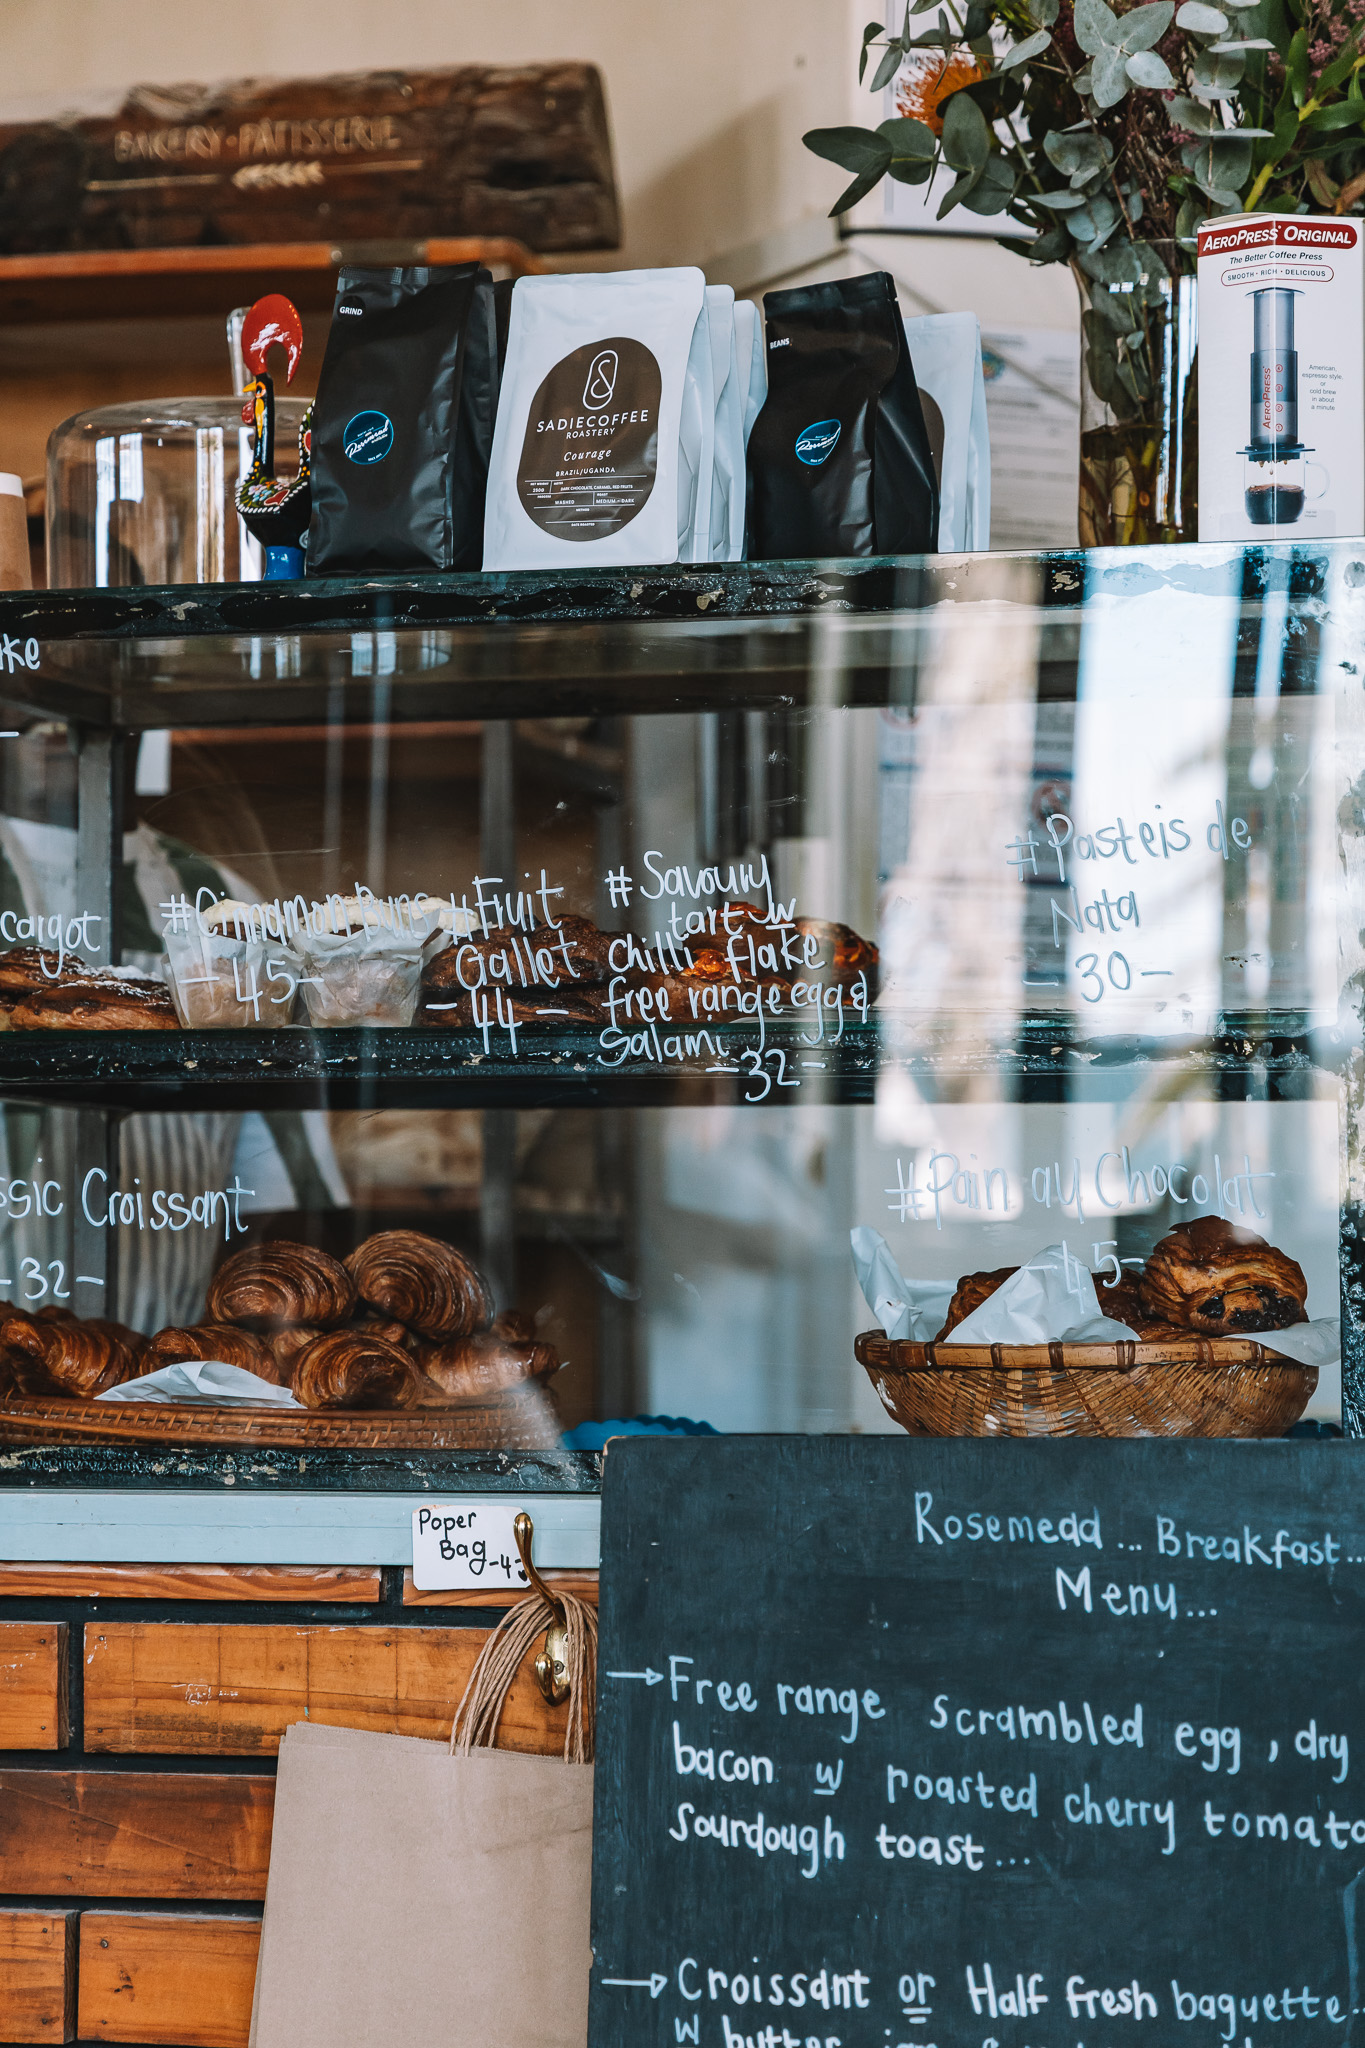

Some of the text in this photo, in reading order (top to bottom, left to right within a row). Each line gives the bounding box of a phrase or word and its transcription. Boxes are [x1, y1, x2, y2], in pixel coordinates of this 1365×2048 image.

[1227, 268, 1326, 281] SMOOTH RICH DELICIOUS
[1229, 251, 1323, 265] The Better Coffee Press
[339, 306, 363, 316] GRIND
[769, 337, 790, 349] BEANS
[563, 449, 612, 462] Courage
[566, 427, 615, 440] ROASTERY
[555, 467, 616, 477] BRAZIL/UGANDA
[1207, 799, 1253, 860] de
[354, 881, 431, 942] Buns
[668, 901, 745, 942] tart
[1050, 885, 1140, 949] Nata
[455, 929, 581, 991] Gallet
[601, 976, 673, 1029] free
[688, 983, 784, 1054] range
[790, 981, 844, 1046] egg
[82, 1167, 256, 1242] Croissant
[1096, 1145, 1277, 1221] Chocolat
[914, 1491, 1103, 1550] Rosemead
[439, 1539, 488, 1576] Bag
[668, 1655, 758, 1712] Free
[776, 1682, 887, 1744] range
[1294, 1718, 1350, 1784] dry
[672, 1720, 774, 1786] bacon
[887, 1764, 1039, 1819] roasted
[1064, 1782, 1176, 1856] cherry
[677, 1956, 871, 2010] Croissant
[899, 1972, 936, 2010] or
[966, 1962, 1049, 2019] Half
[1065, 1974, 1158, 2020] fresh
